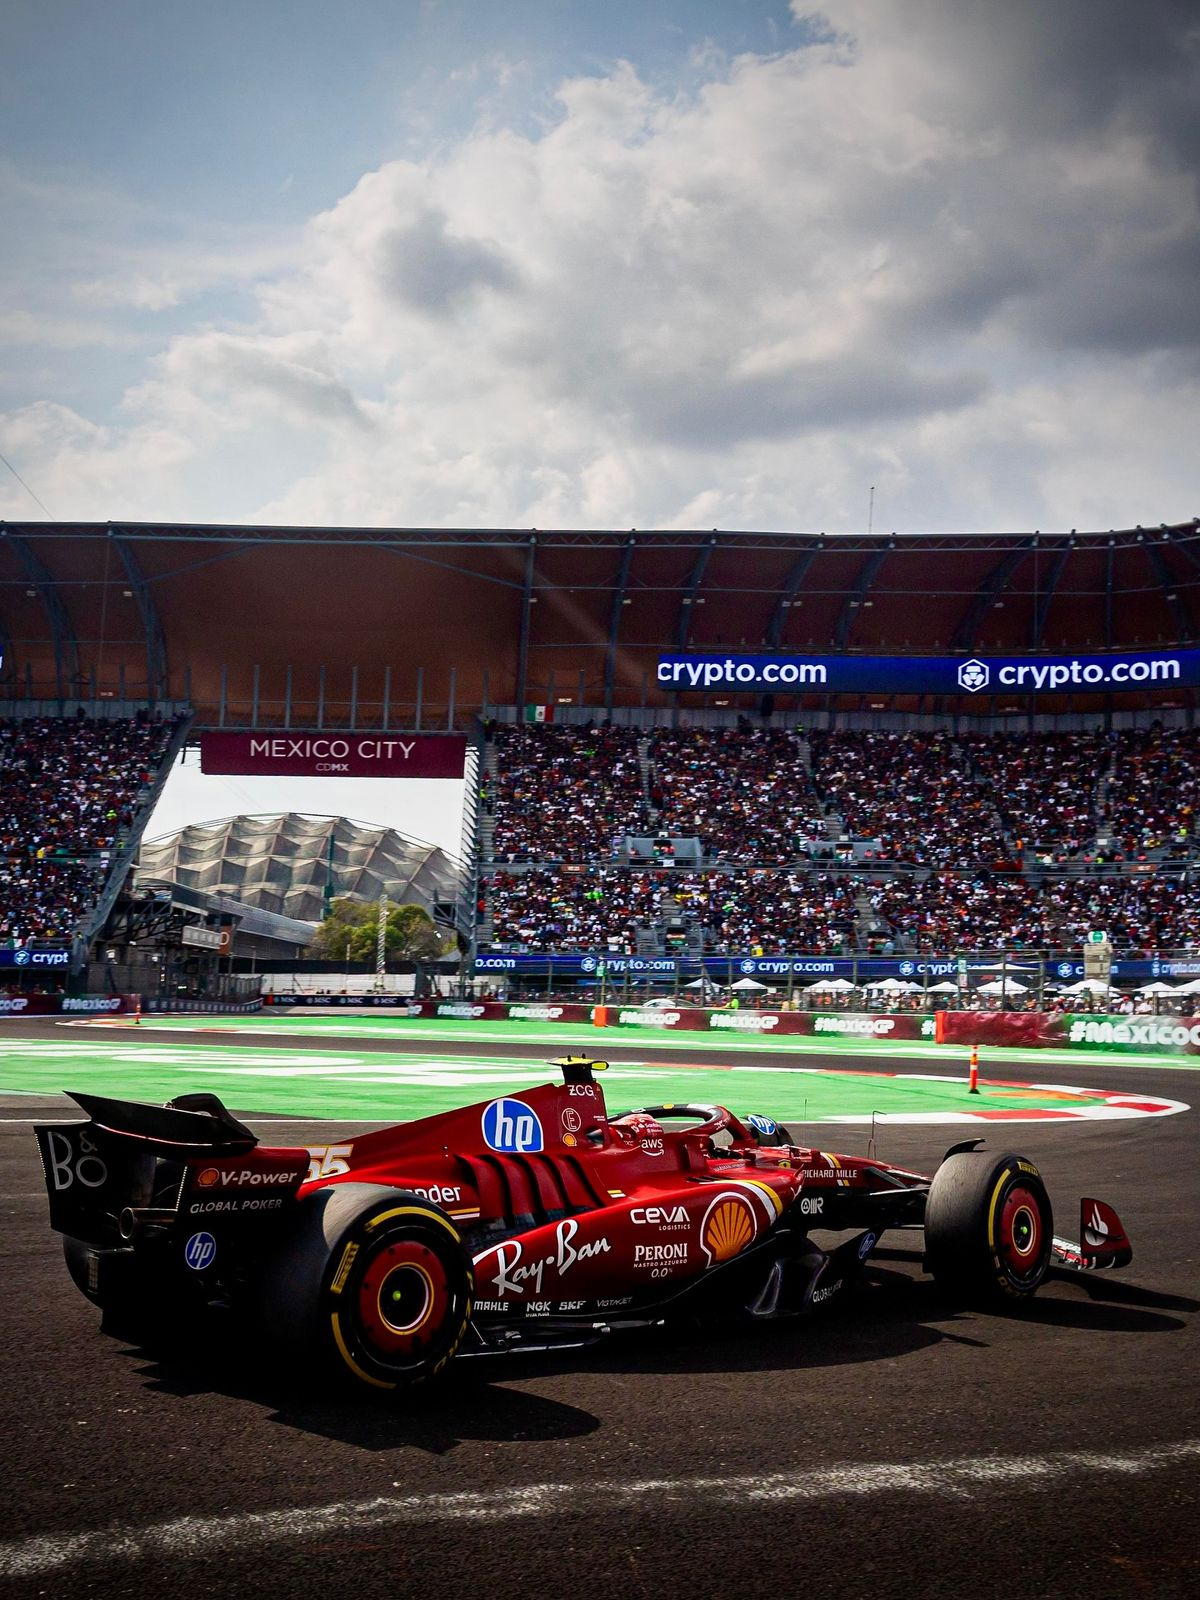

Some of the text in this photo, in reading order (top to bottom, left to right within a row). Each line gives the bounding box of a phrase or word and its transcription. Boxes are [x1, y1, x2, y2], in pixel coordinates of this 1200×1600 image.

[657, 659, 827, 686] crypto.com
[998, 658, 1181, 689] crypto.com
[250, 739, 416, 759] MEXICO CITY
[315, 762, 350, 772] CDMX
[32, 951, 69, 965] crypt
[709, 1014, 779, 1029] #MexicoGP
[813, 1017, 895, 1033] #MexicoGP
[492, 1098, 536, 1152] hp
[641, 1138, 664, 1149] aws
[221, 1170, 298, 1186] V-Power
[835, 1169, 858, 1178] MILLE
[406, 1184, 461, 1203] nder
[189, 1199, 283, 1214] GLOBAL POKER
[189, 1232, 214, 1269] hp
[634, 1243, 688, 1262] PERONI
[473, 1301, 510, 1311] MAHLE
[526, 1301, 551, 1311] NGK
[558, 1300, 587, 1311] SKF
